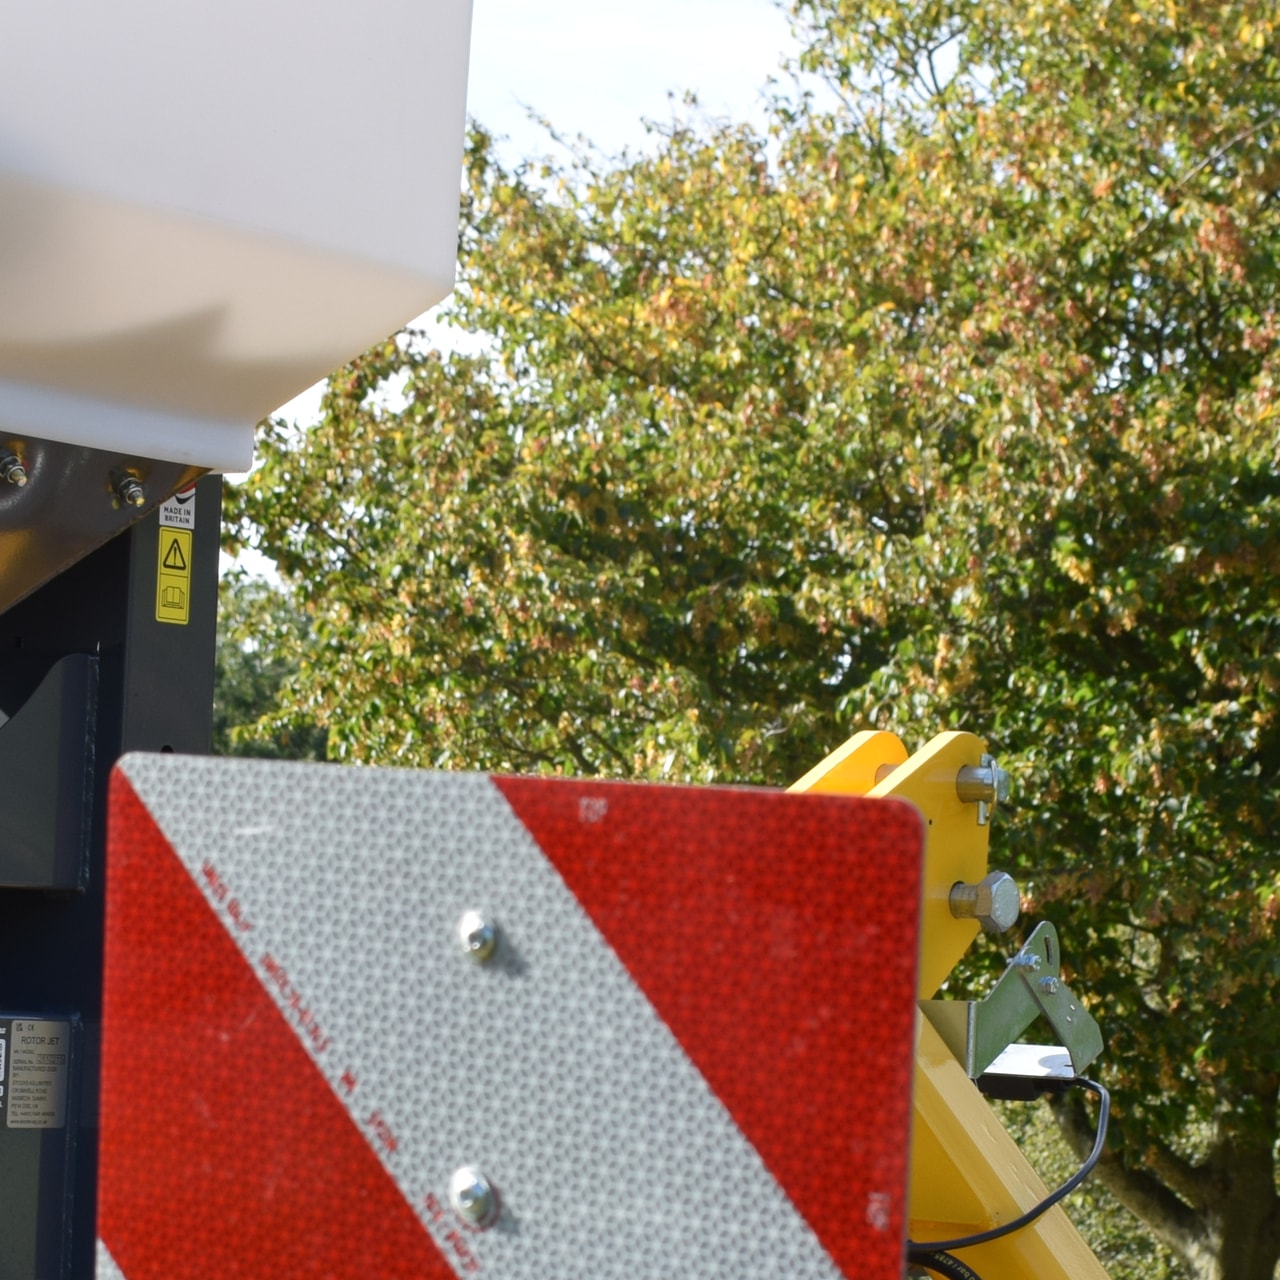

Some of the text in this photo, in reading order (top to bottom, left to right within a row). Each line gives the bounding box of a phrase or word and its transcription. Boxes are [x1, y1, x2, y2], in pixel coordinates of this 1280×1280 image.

[164, 506, 182, 515] MADE
[164, 515, 190, 524] BRITAIN
[21, 1036, 60, 1046] ROTOR JET
